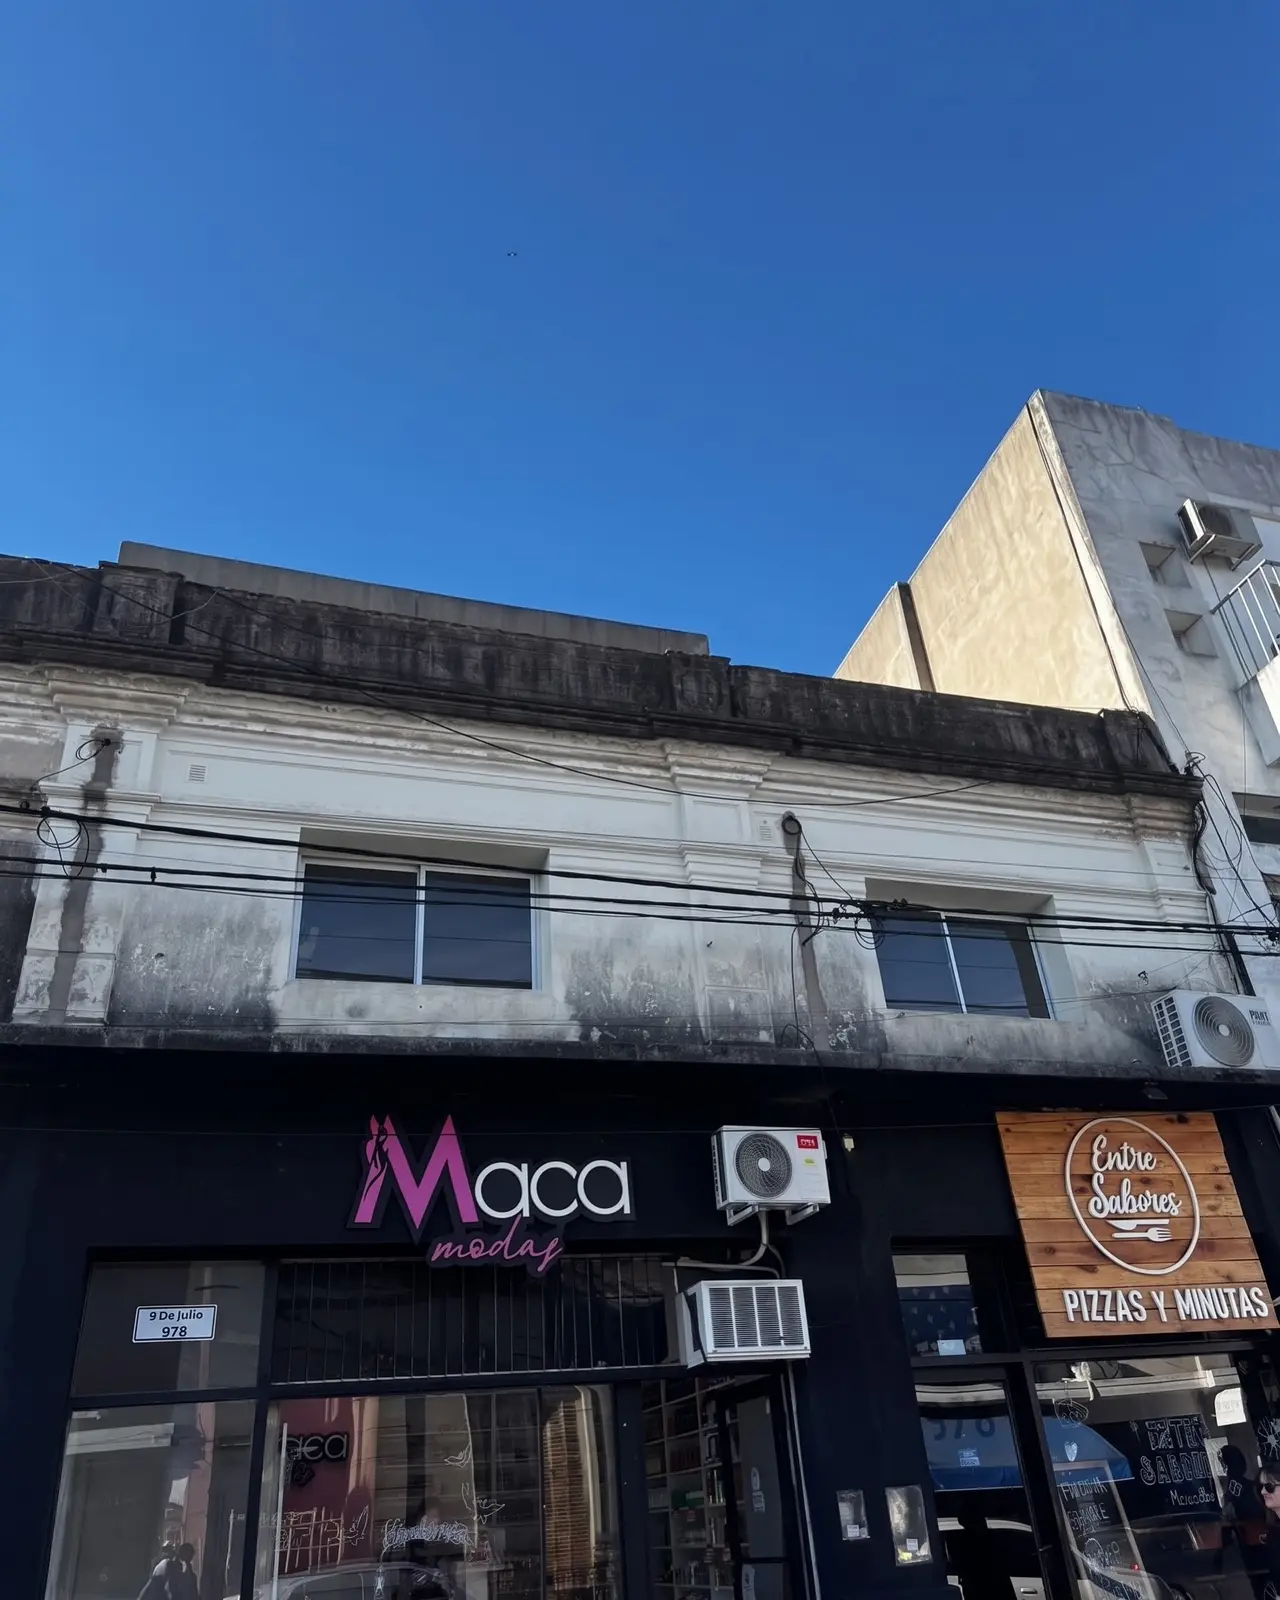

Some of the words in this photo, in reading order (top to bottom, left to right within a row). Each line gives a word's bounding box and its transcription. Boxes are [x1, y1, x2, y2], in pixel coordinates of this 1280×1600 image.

[354, 1114, 631, 1229] Maca
[1092, 1134, 1157, 1172] Entre
[1088, 1172, 1182, 1218] Sabores
[430, 1214, 563, 1272] modas
[149, 1311, 157, 1321] 9
[159, 1311, 175, 1321] De
[176, 1309, 203, 1322] Julio
[1063, 1289, 1148, 1322] PIZZAS
[1150, 1290, 1168, 1322] Y
[1173, 1286, 1269, 1321] MINUTAS
[161, 1325, 188, 1338] 978
